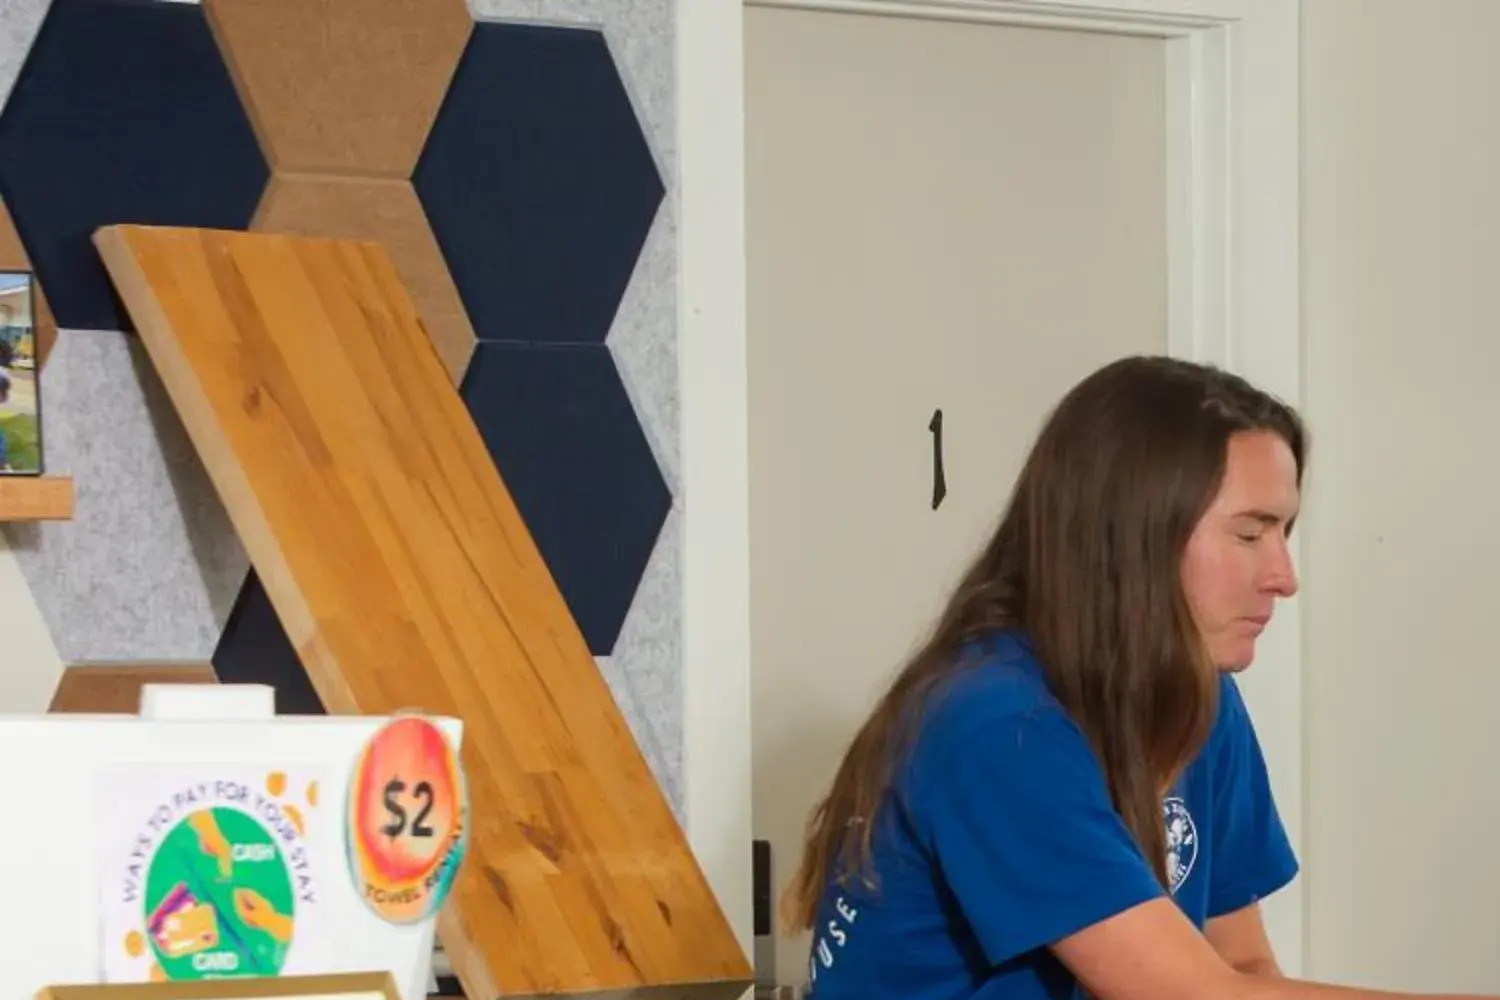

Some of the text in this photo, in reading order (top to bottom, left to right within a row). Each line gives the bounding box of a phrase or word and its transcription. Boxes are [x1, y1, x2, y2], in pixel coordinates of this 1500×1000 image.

[122, 779, 317, 904] WAYS TO PAY FOR YOUR STAY
[379, 775, 435, 843] $2
[809, 897, 858, 984] USE
